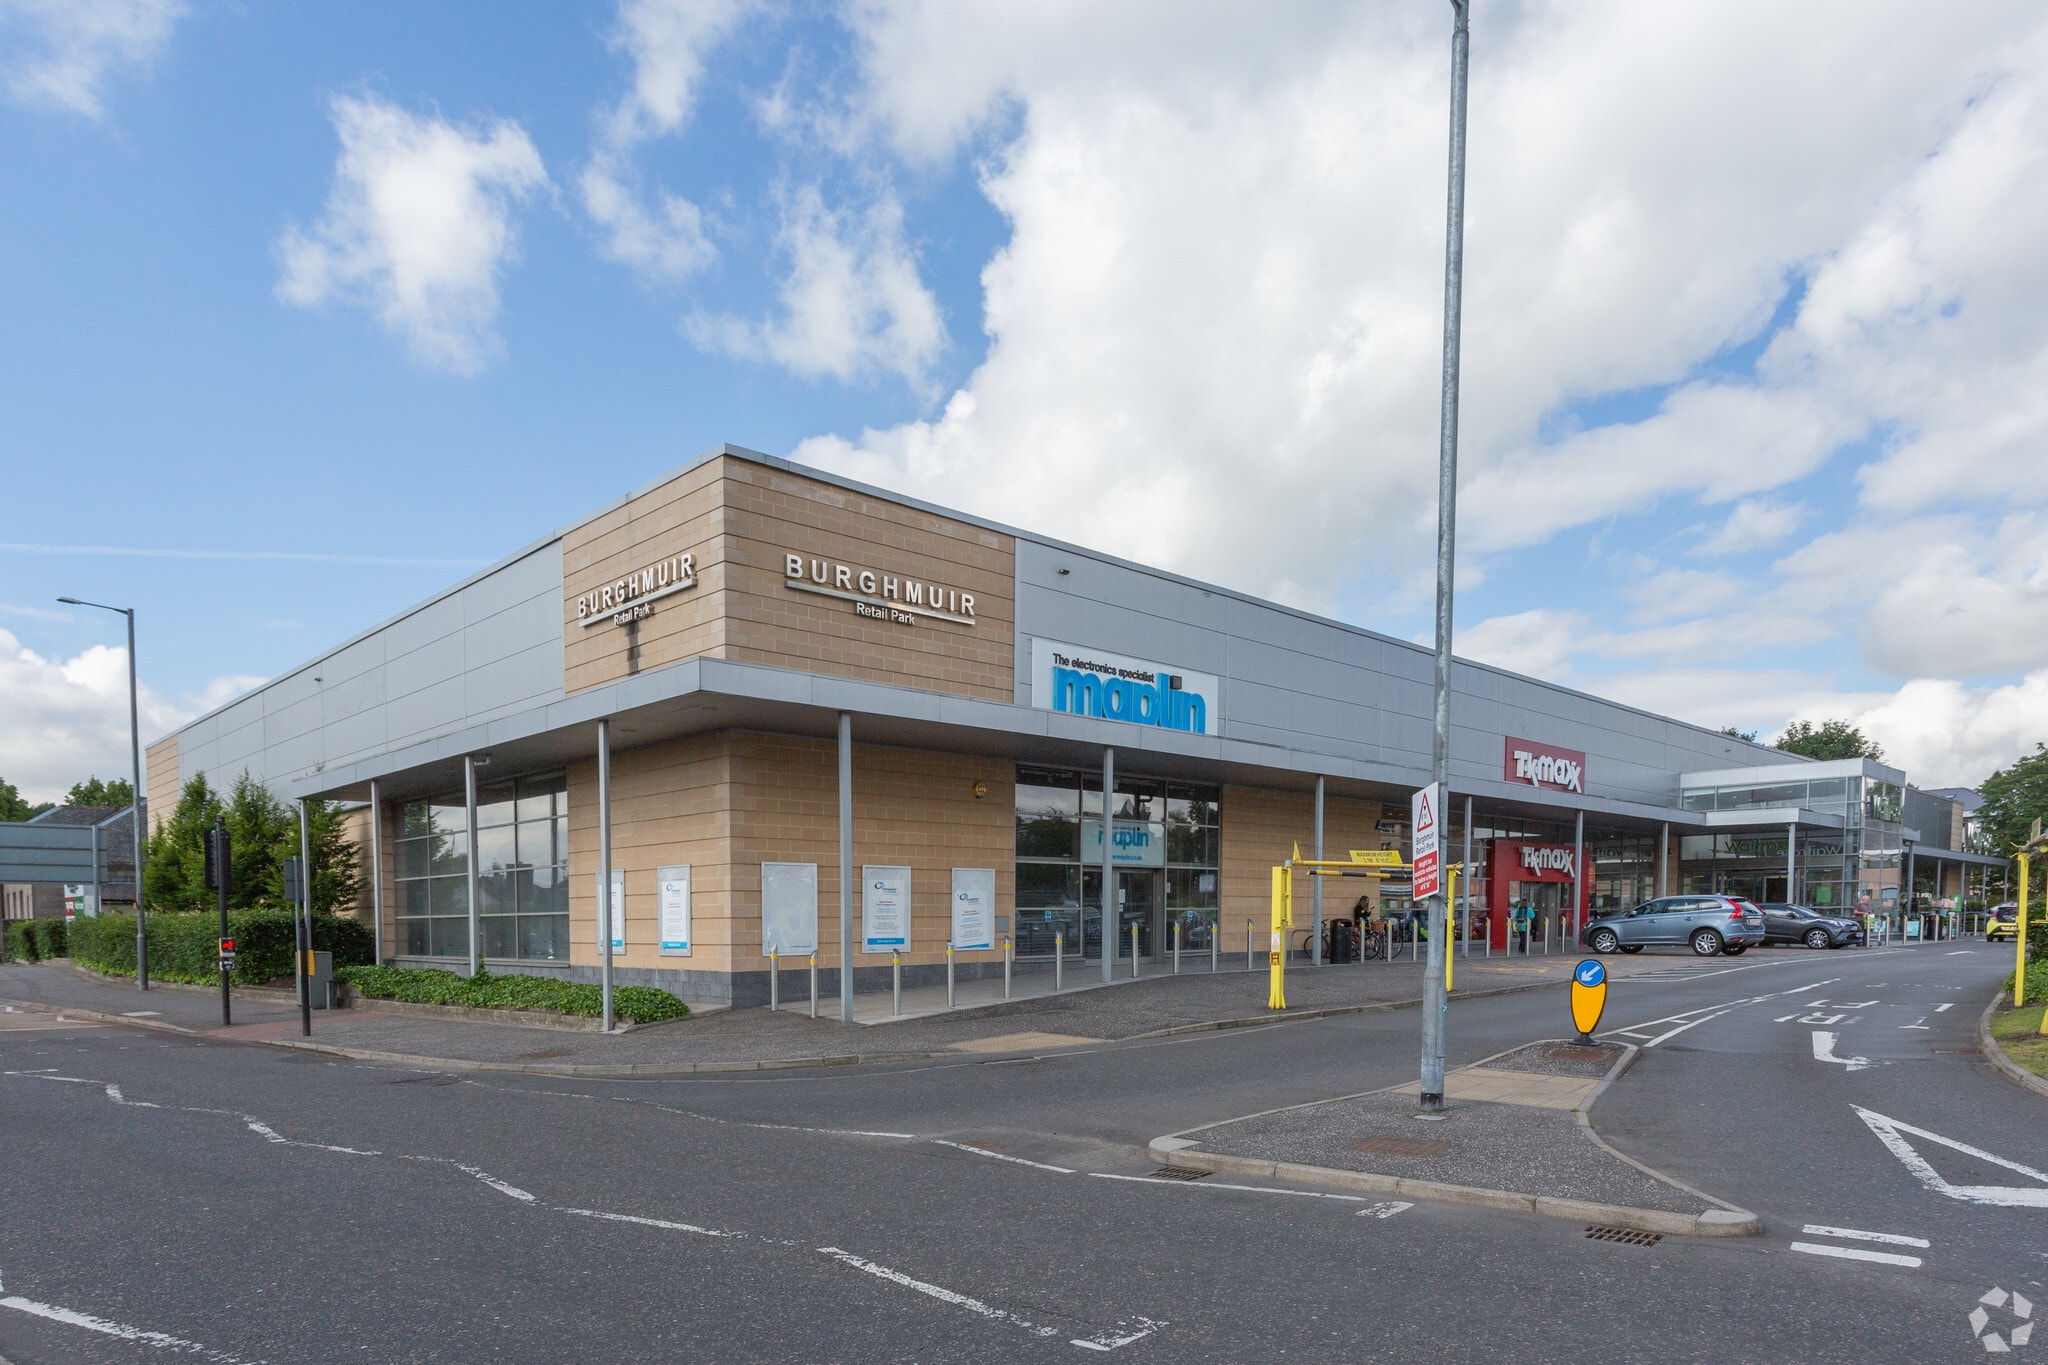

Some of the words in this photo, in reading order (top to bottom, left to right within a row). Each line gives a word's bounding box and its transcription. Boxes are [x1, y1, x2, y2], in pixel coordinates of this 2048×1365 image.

[578, 553, 697, 618] BURGHMUIR
[785, 553, 976, 616] BURGHMUIR
[613, 610, 632, 626] Retail
[634, 602, 651, 619] Park
[856, 602, 888, 620] Retail
[891, 609, 915, 625] Park
[1053, 653, 1070, 666] The
[1071, 658, 1117, 675] electronics
[1118, 668, 1155, 683] specialist
[1053, 667, 1206, 734] maplin
